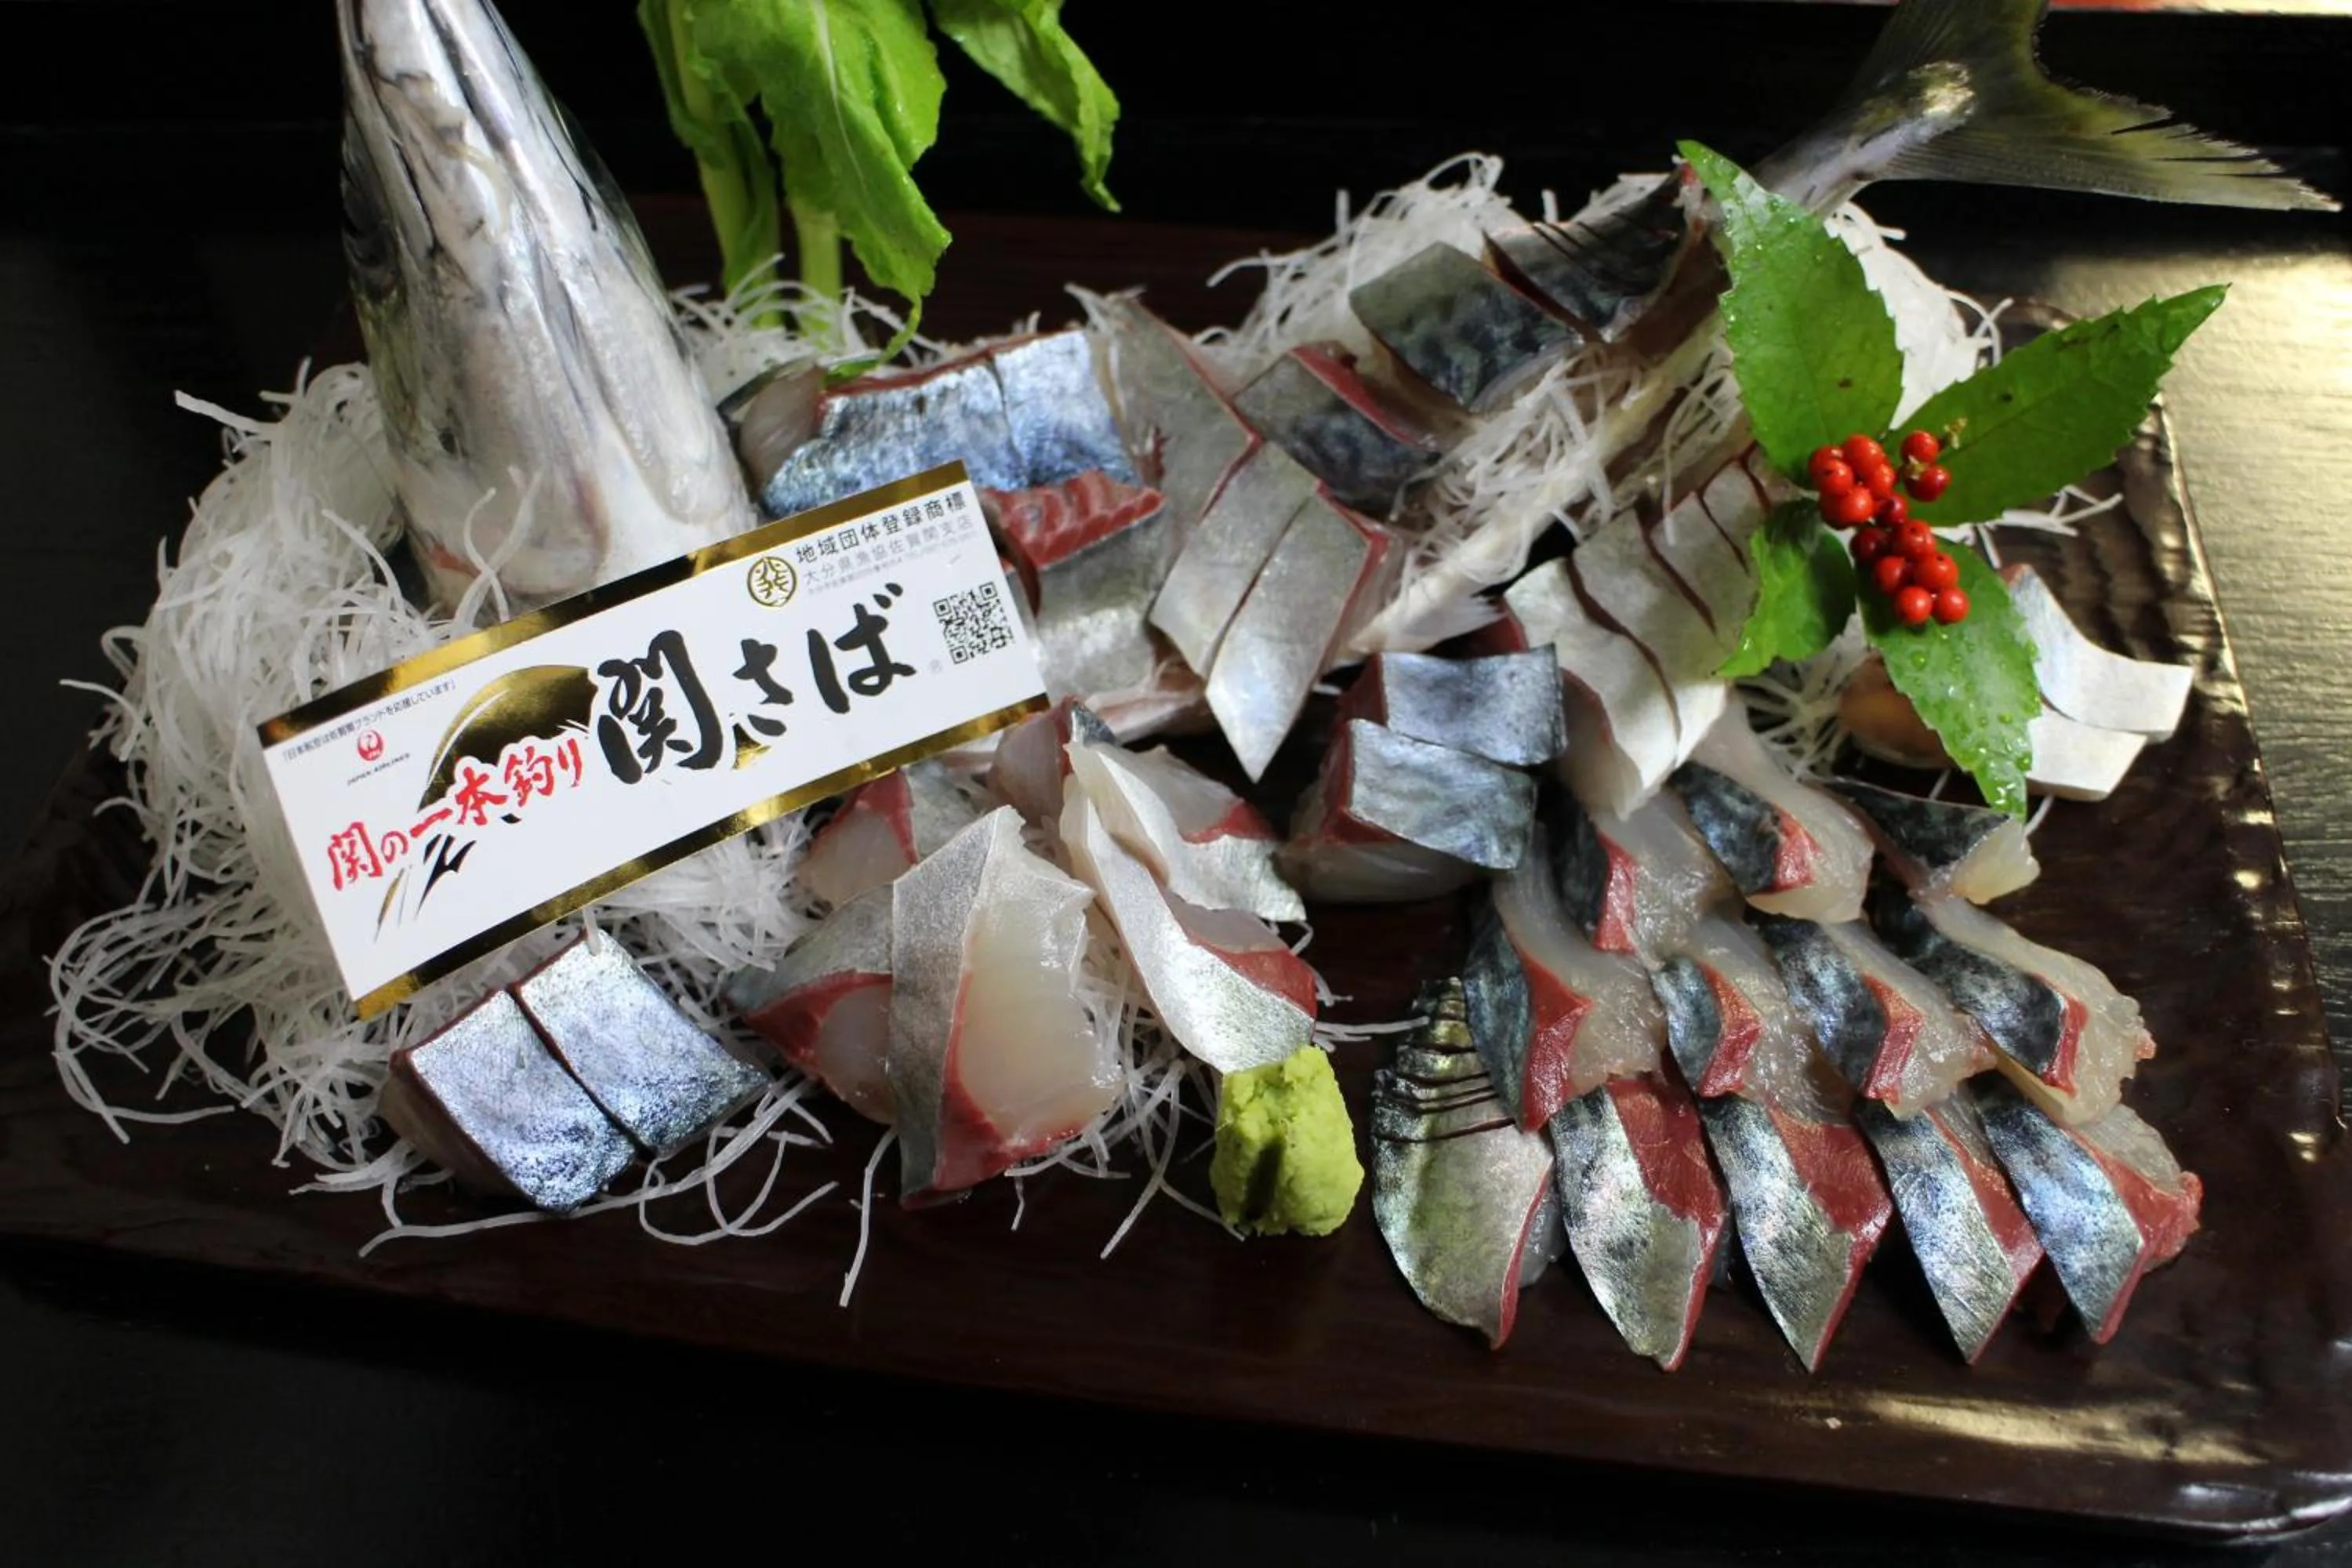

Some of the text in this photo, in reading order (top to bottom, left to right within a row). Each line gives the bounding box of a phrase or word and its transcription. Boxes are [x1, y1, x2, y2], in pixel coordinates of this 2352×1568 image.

[795, 491, 967, 564] 地域団体登録商標
[597, 583, 916, 785] 関さば
[327, 737, 582, 891] 関の一本釣り
